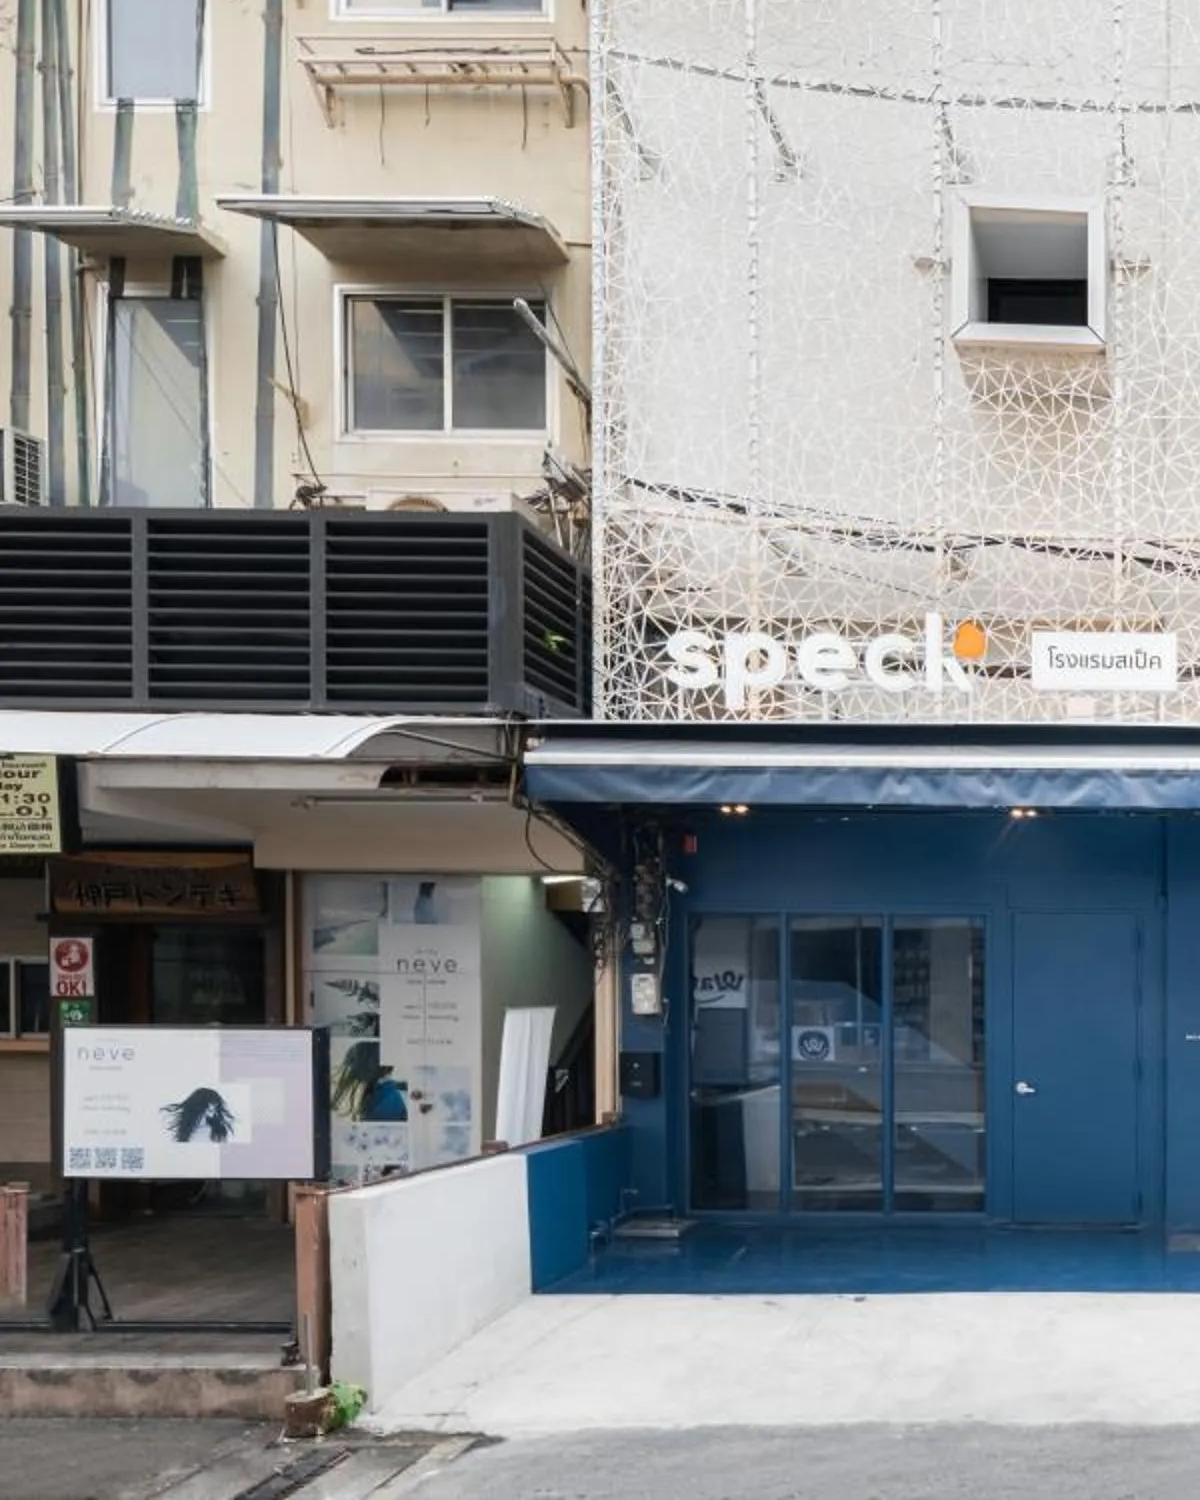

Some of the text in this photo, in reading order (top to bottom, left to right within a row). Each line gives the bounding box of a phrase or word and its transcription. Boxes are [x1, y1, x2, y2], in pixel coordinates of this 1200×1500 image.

[666, 612, 987, 711] speck
[0, 770, 40, 779] our
[397, 959, 459, 973] neve
[78, 1047, 136, 1061] neve
